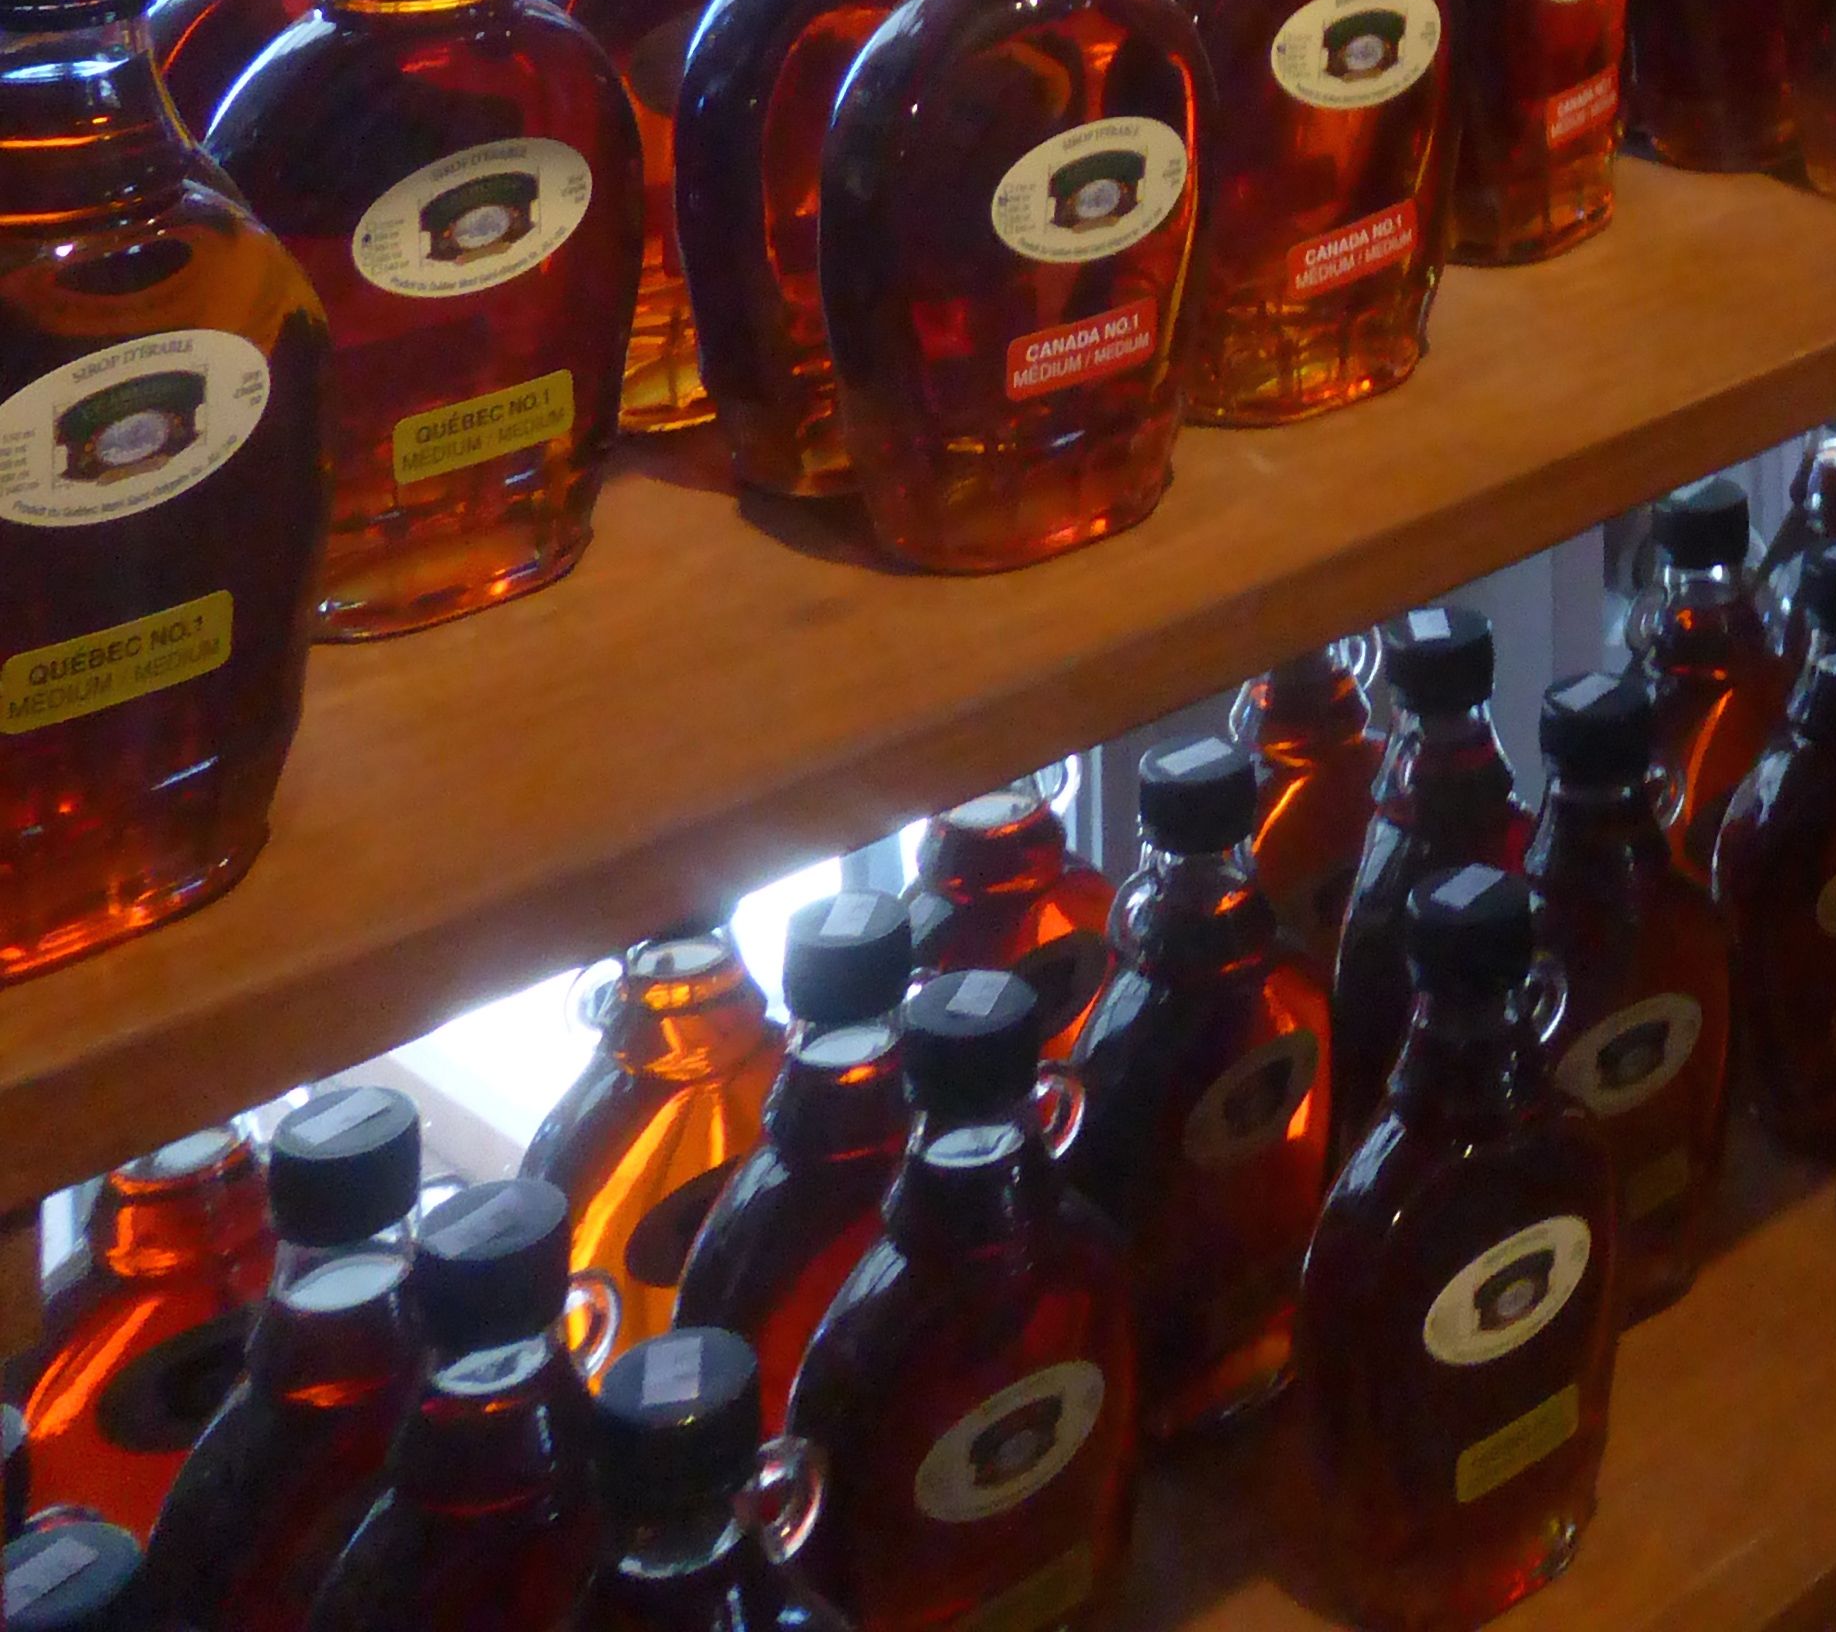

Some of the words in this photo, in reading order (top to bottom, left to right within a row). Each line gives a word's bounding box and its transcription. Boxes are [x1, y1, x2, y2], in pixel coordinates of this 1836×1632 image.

[1306, 229, 1369, 266] CANADA
[1026, 327, 1100, 363] CANADA
[1132, 313, 1139, 329] 1
[1094, 332, 1149, 366] MEDIUM
[416, 404, 504, 444] QUÉBEC
[29, 634, 143, 686] QUÉBEC
